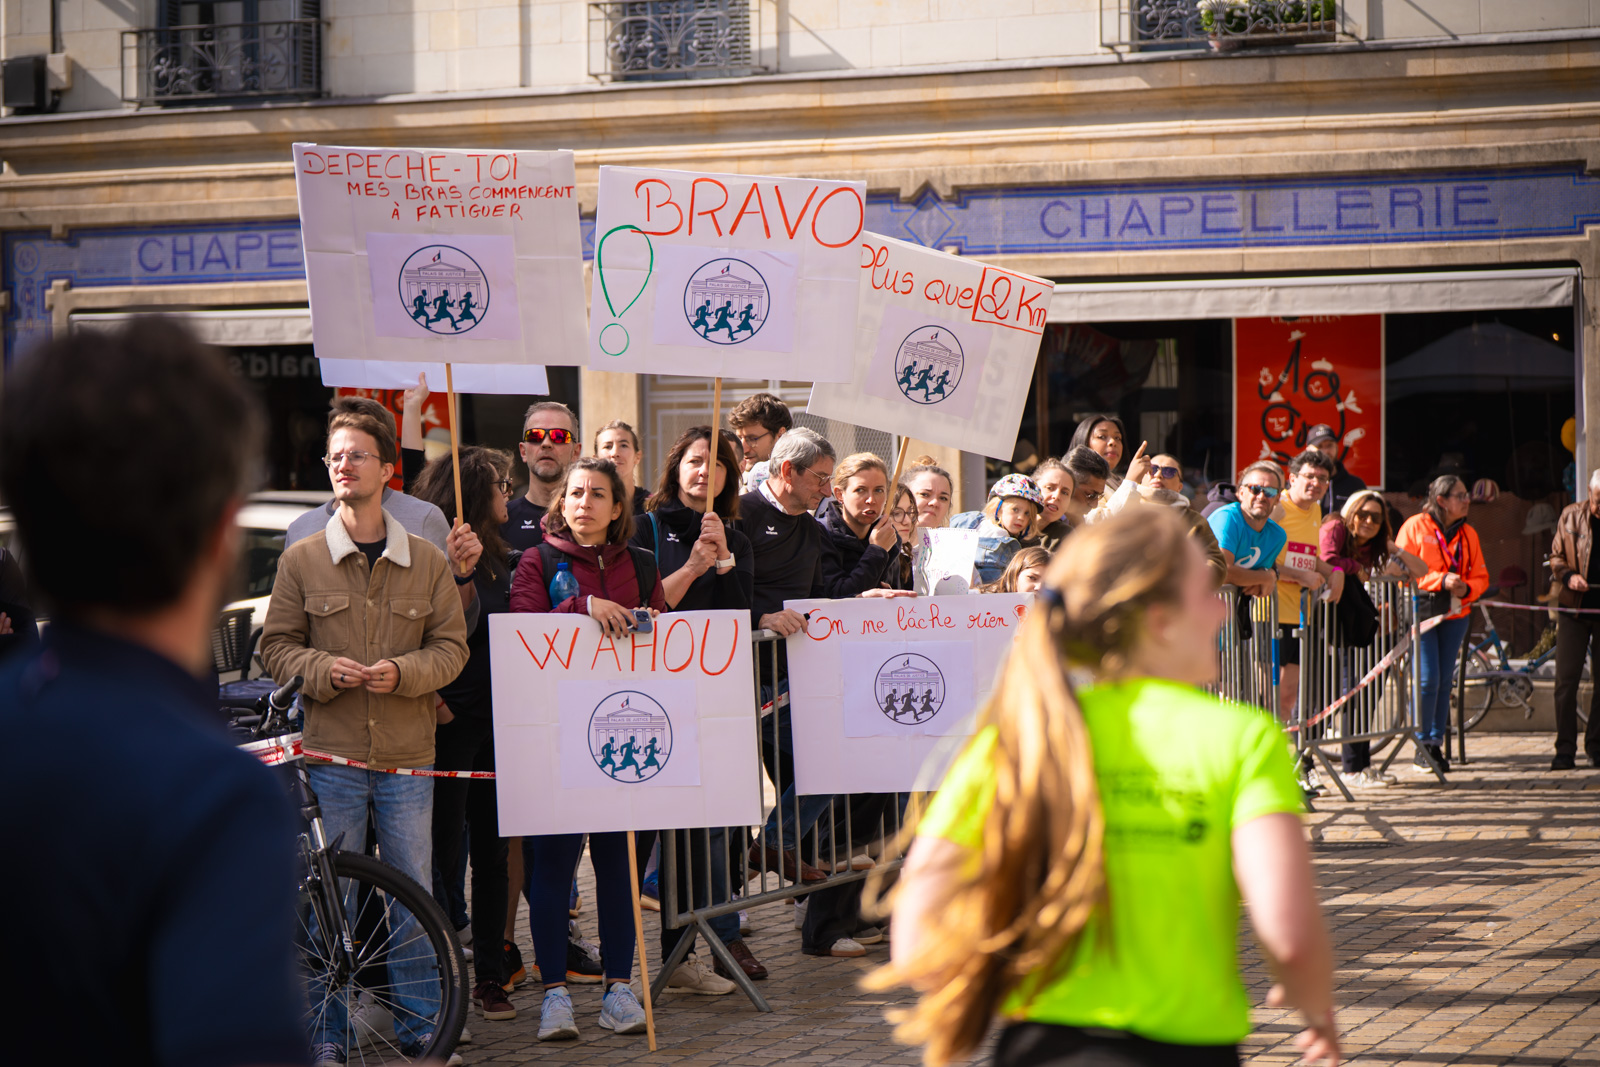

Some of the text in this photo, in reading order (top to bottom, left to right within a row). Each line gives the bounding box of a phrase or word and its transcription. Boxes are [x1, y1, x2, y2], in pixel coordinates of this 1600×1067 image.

[347, 181, 575, 201] MES BRAS COMMENCENT
[391, 202, 400, 220] À
[630, 177, 864, 248] BRAVO
[1039, 184, 1500, 238] CHAPELLERIE
[860, 619, 888, 635] ne
[967, 611, 1009, 630] rien
[516, 618, 739, 676] WAHOU
